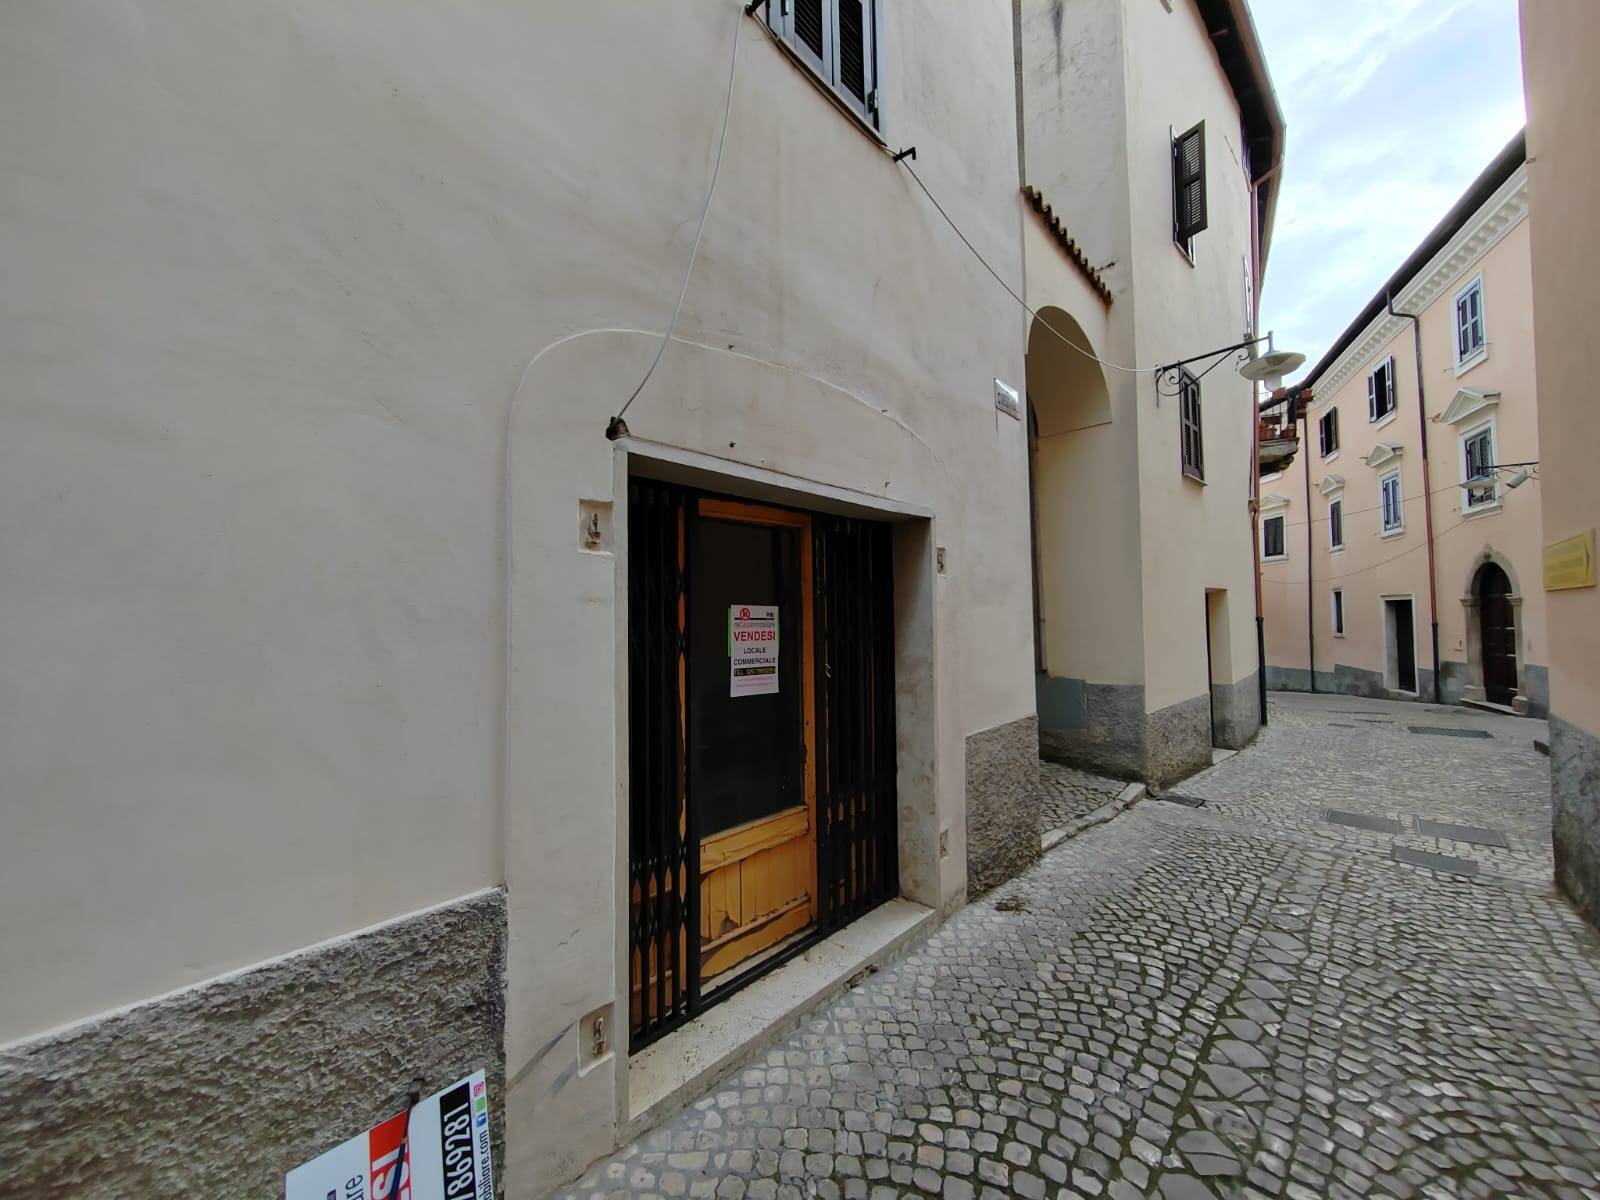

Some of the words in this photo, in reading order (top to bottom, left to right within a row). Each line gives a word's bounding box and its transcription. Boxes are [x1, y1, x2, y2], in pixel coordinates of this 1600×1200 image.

[734, 631, 776, 641] VENDESI
[743, 647, 767, 655] LOCALE
[733, 657, 776, 665] COMMERCIALE
[372, 1142, 410, 1200] SI
